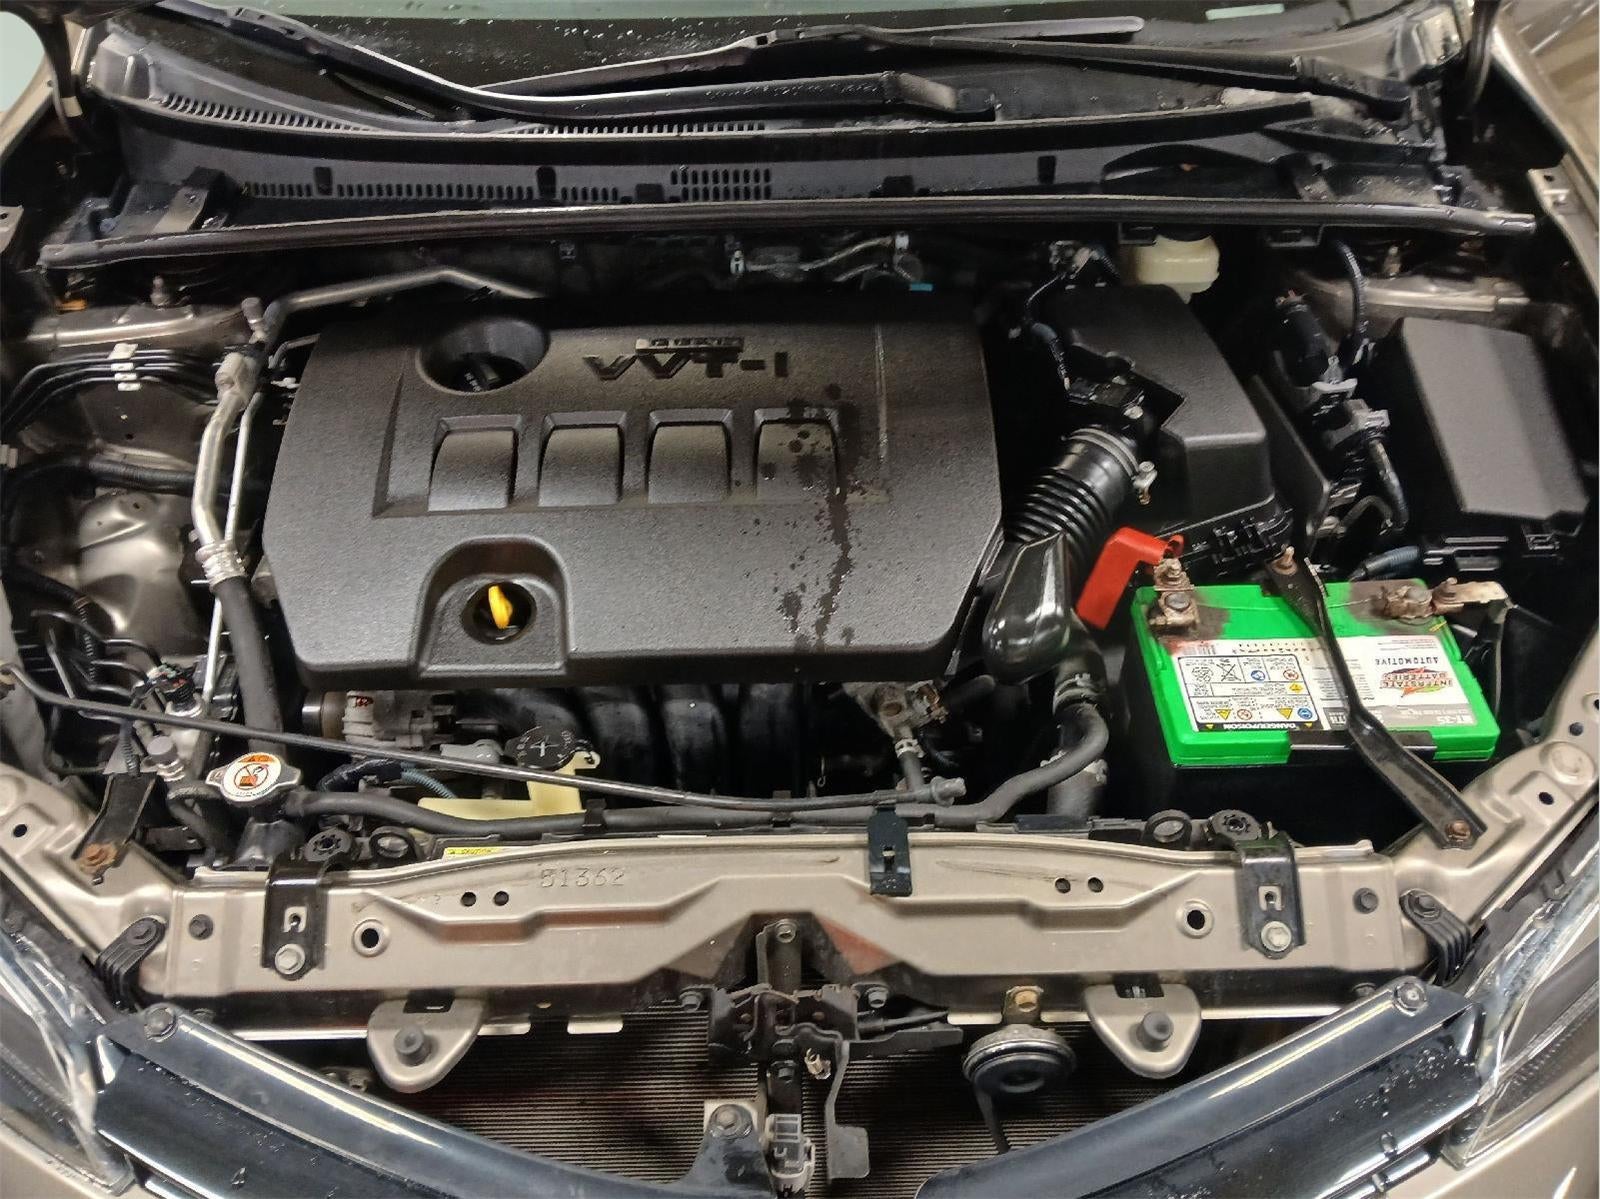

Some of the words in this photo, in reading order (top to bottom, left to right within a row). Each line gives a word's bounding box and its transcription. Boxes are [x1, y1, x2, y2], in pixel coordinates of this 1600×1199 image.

[1374, 656, 1439, 666] AUTOMOTIVE
[1382, 672, 1448, 681] BATTERIES
[1381, 678, 1452, 688] INTERSTATE
